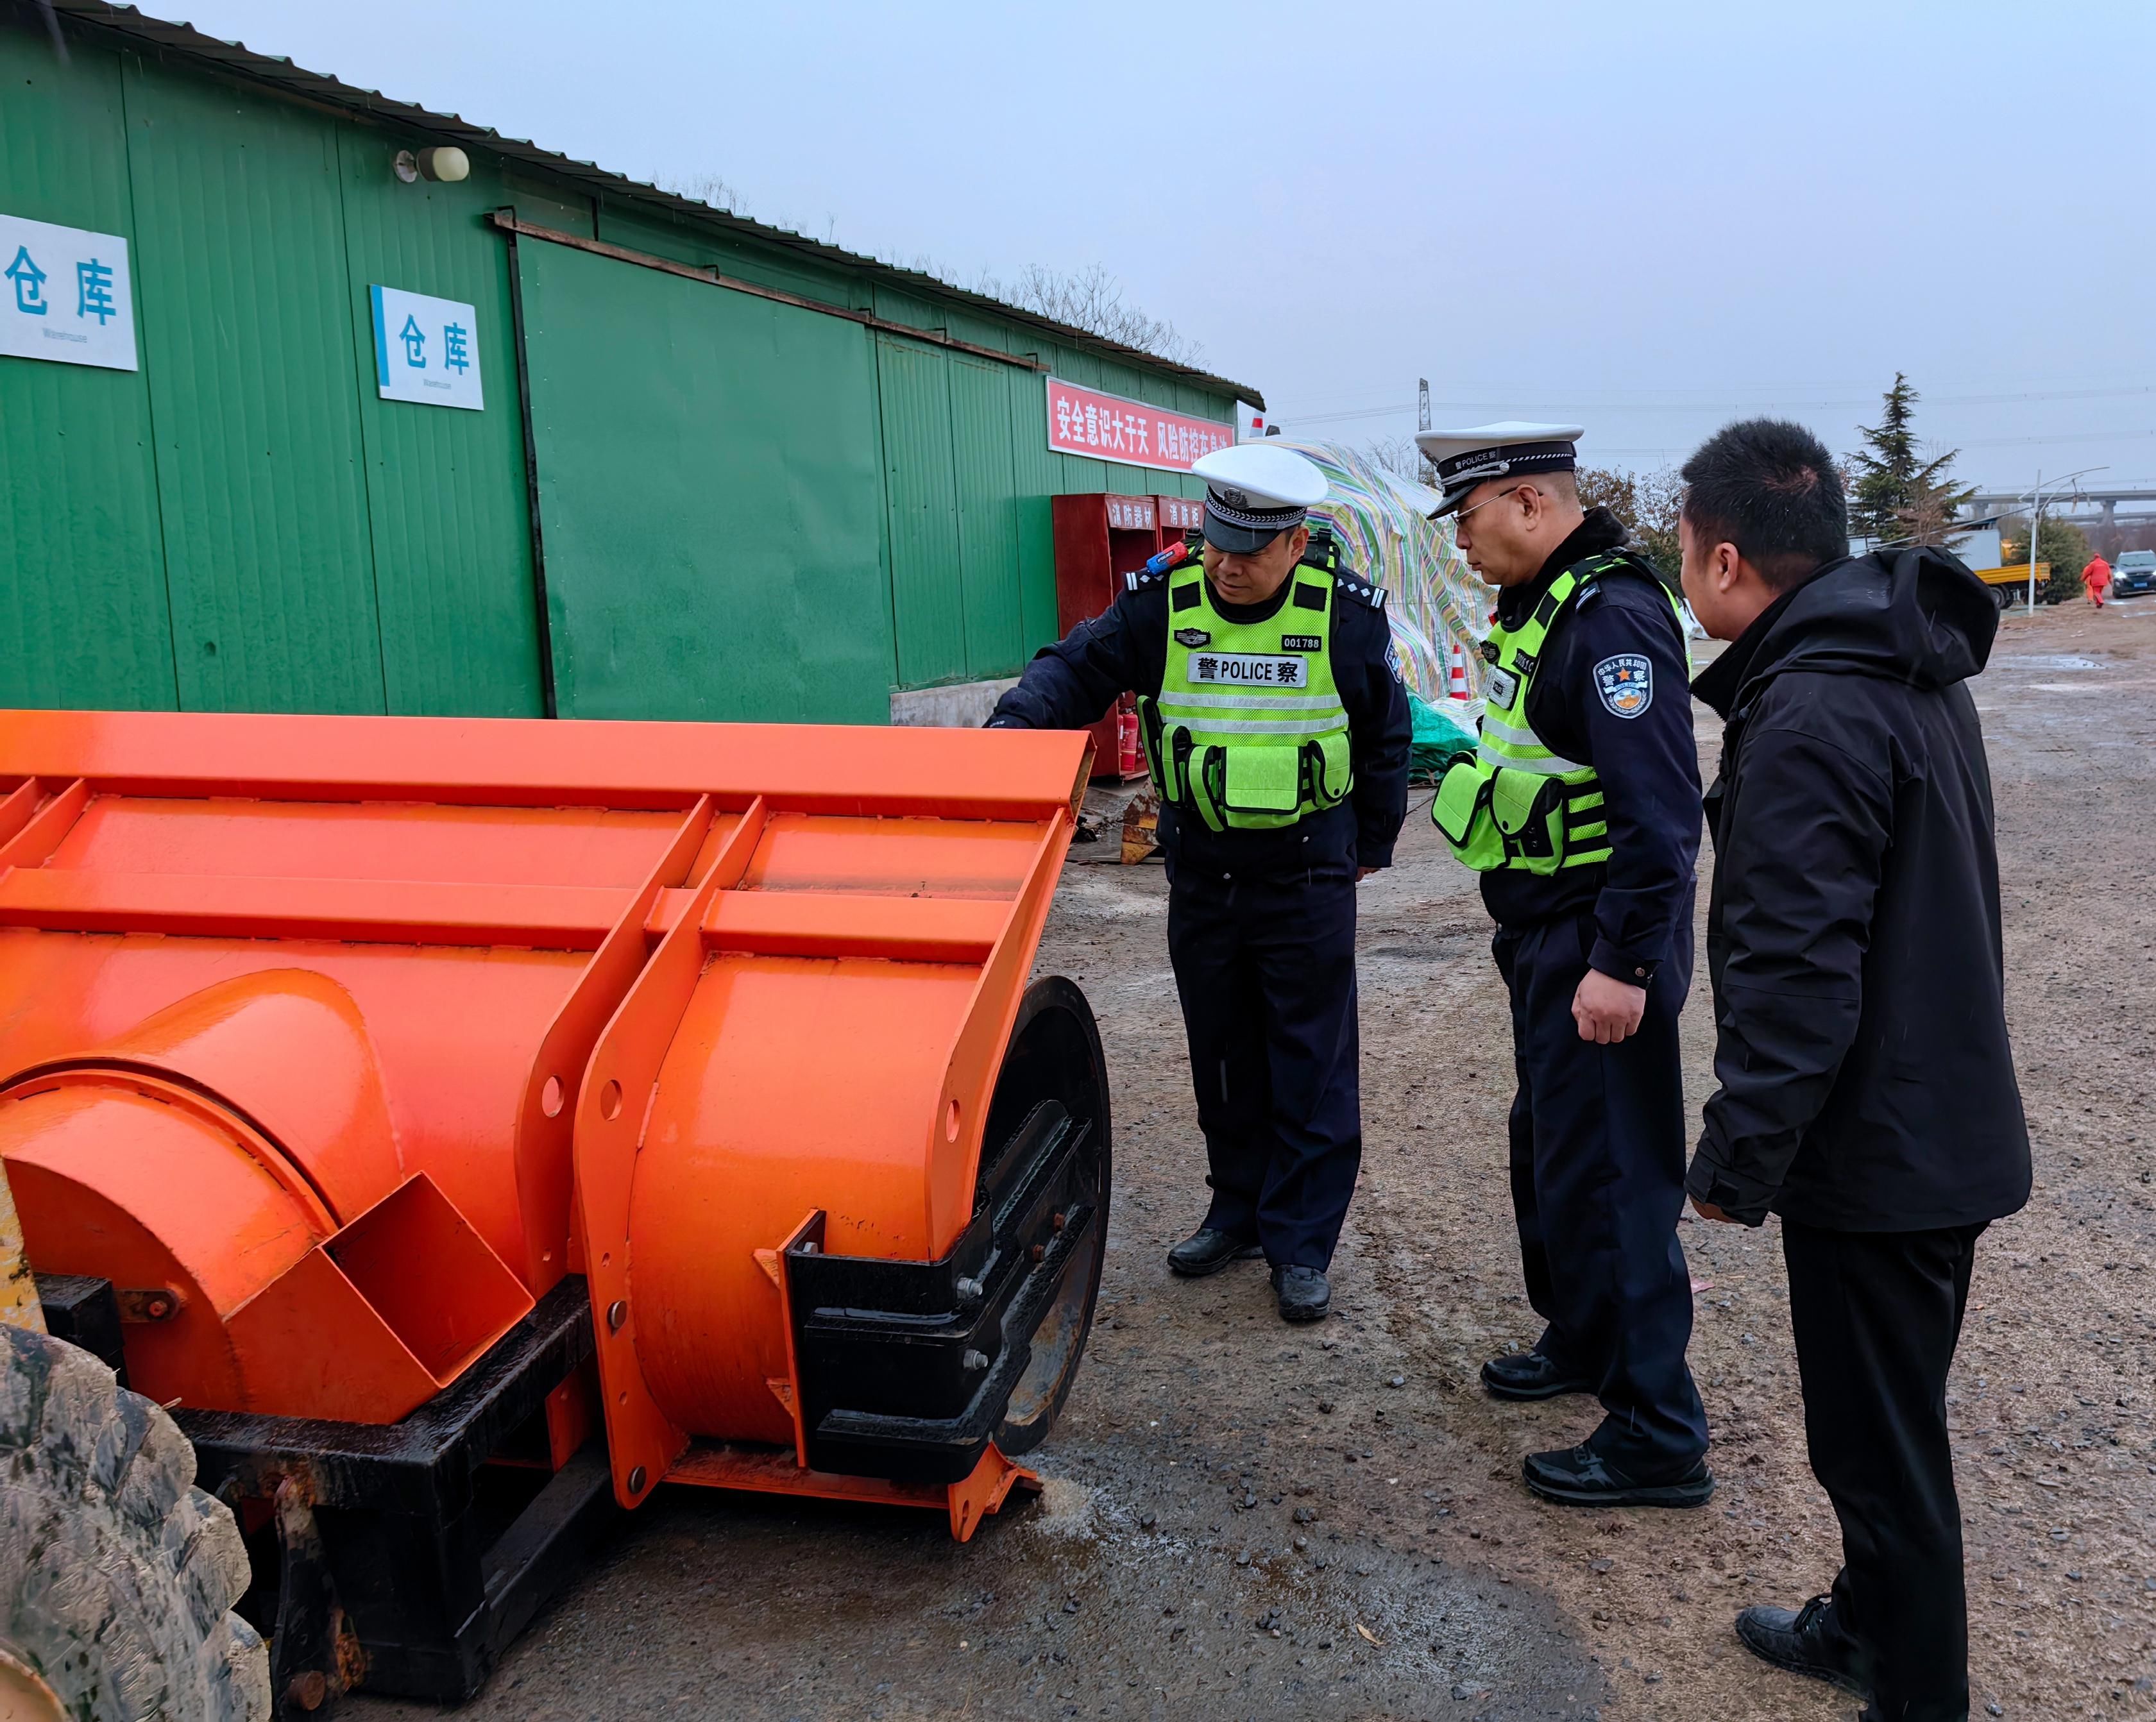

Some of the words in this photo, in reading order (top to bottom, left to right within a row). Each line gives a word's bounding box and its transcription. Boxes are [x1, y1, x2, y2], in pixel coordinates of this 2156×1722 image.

[4, 244, 117, 326] 仓库
[399, 314, 470, 375] 仓库
[1057, 396, 1150, 455] 安全意识大于天
[1462, 453, 1488, 467] POLICE
[1112, 502, 1152, 529] 消防器材
[1284, 637, 1320, 648] 001788
[1198, 657, 1218, 680] 警
[1221, 661, 1272, 680] POLICE
[1277, 662, 1298, 683] 察
[1597, 658, 1647, 676] 中华人民共和国
